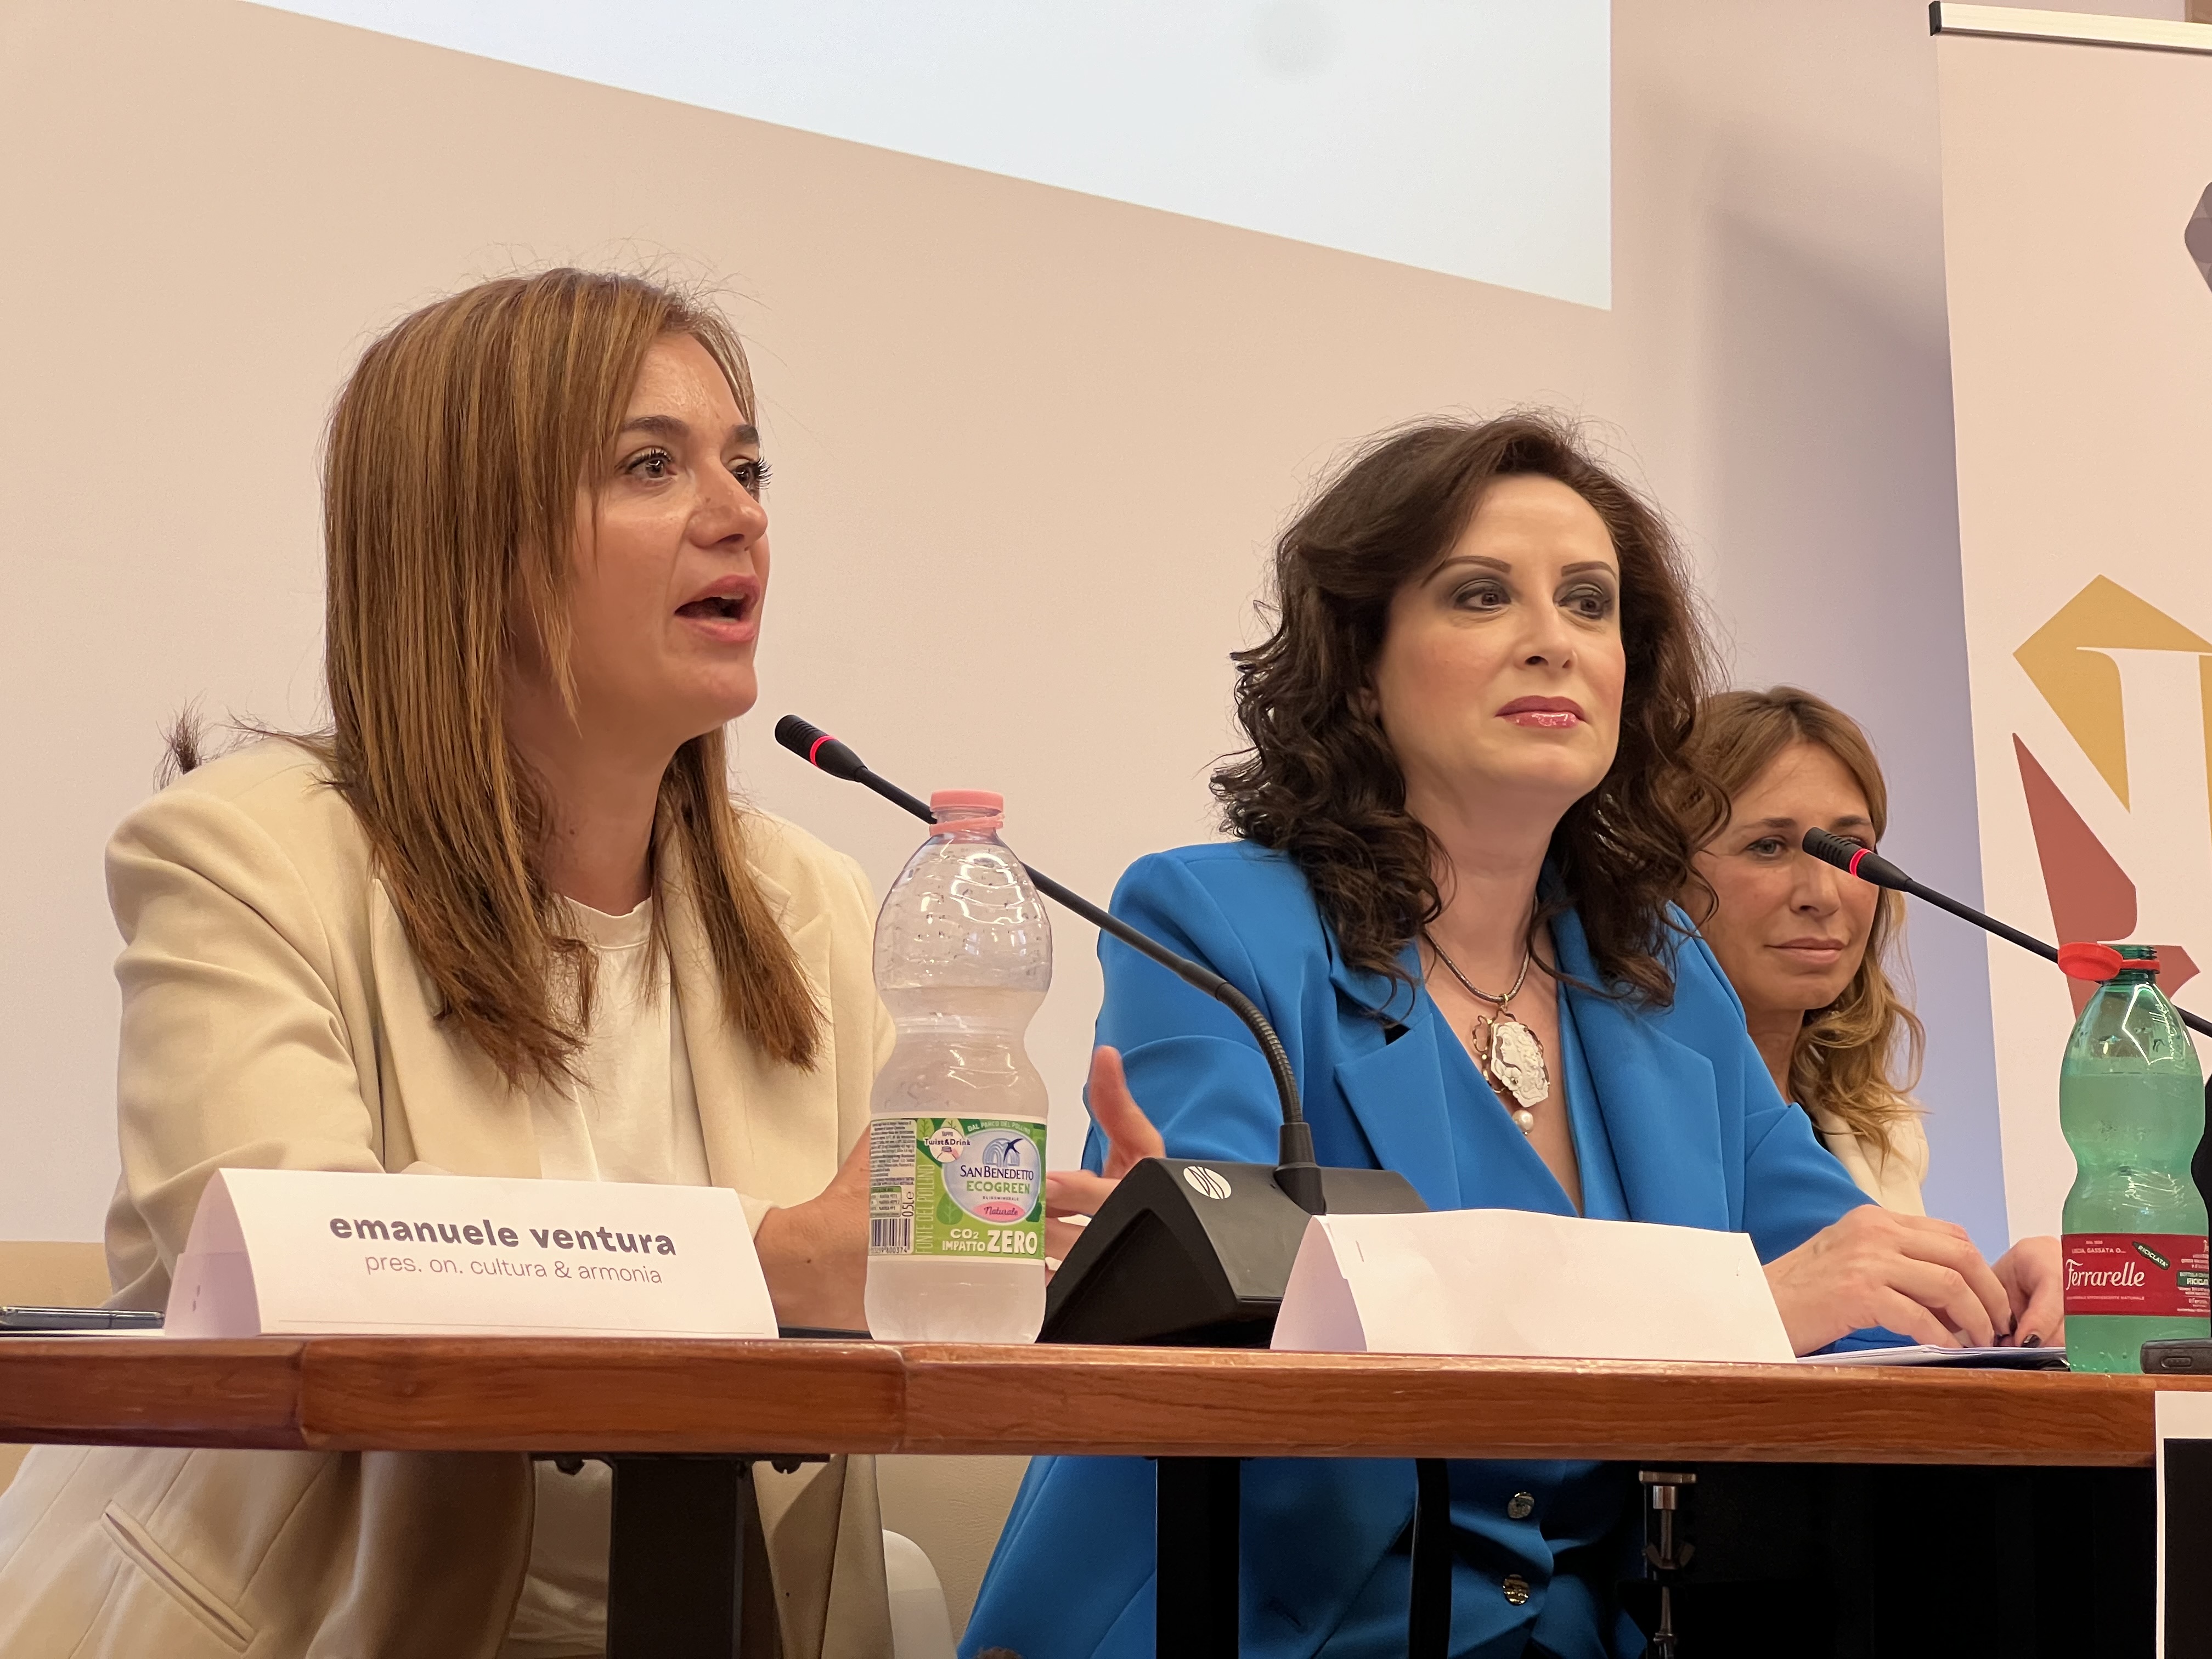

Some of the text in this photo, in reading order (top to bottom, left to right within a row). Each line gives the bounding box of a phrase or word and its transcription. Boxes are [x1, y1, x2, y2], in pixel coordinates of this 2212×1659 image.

[967, 1124, 980, 1132] DAL
[960, 1165, 1034, 1181] SAN BENEDETTO
[967, 1181, 1030, 1194] ECOGREEN
[915, 1164, 935, 1254] FONTE DEL POLLINO
[984, 1206, 1018, 1216] Naturale
[329, 1218, 676, 1256] emanuele ventura
[942, 1240, 986, 1252] IMPATTO
[987, 1229, 1037, 1255] ZERO
[365, 1256, 663, 1284] pres. on. cultura & armonia
[2066, 1259, 2146, 1290] Ferrarelle
